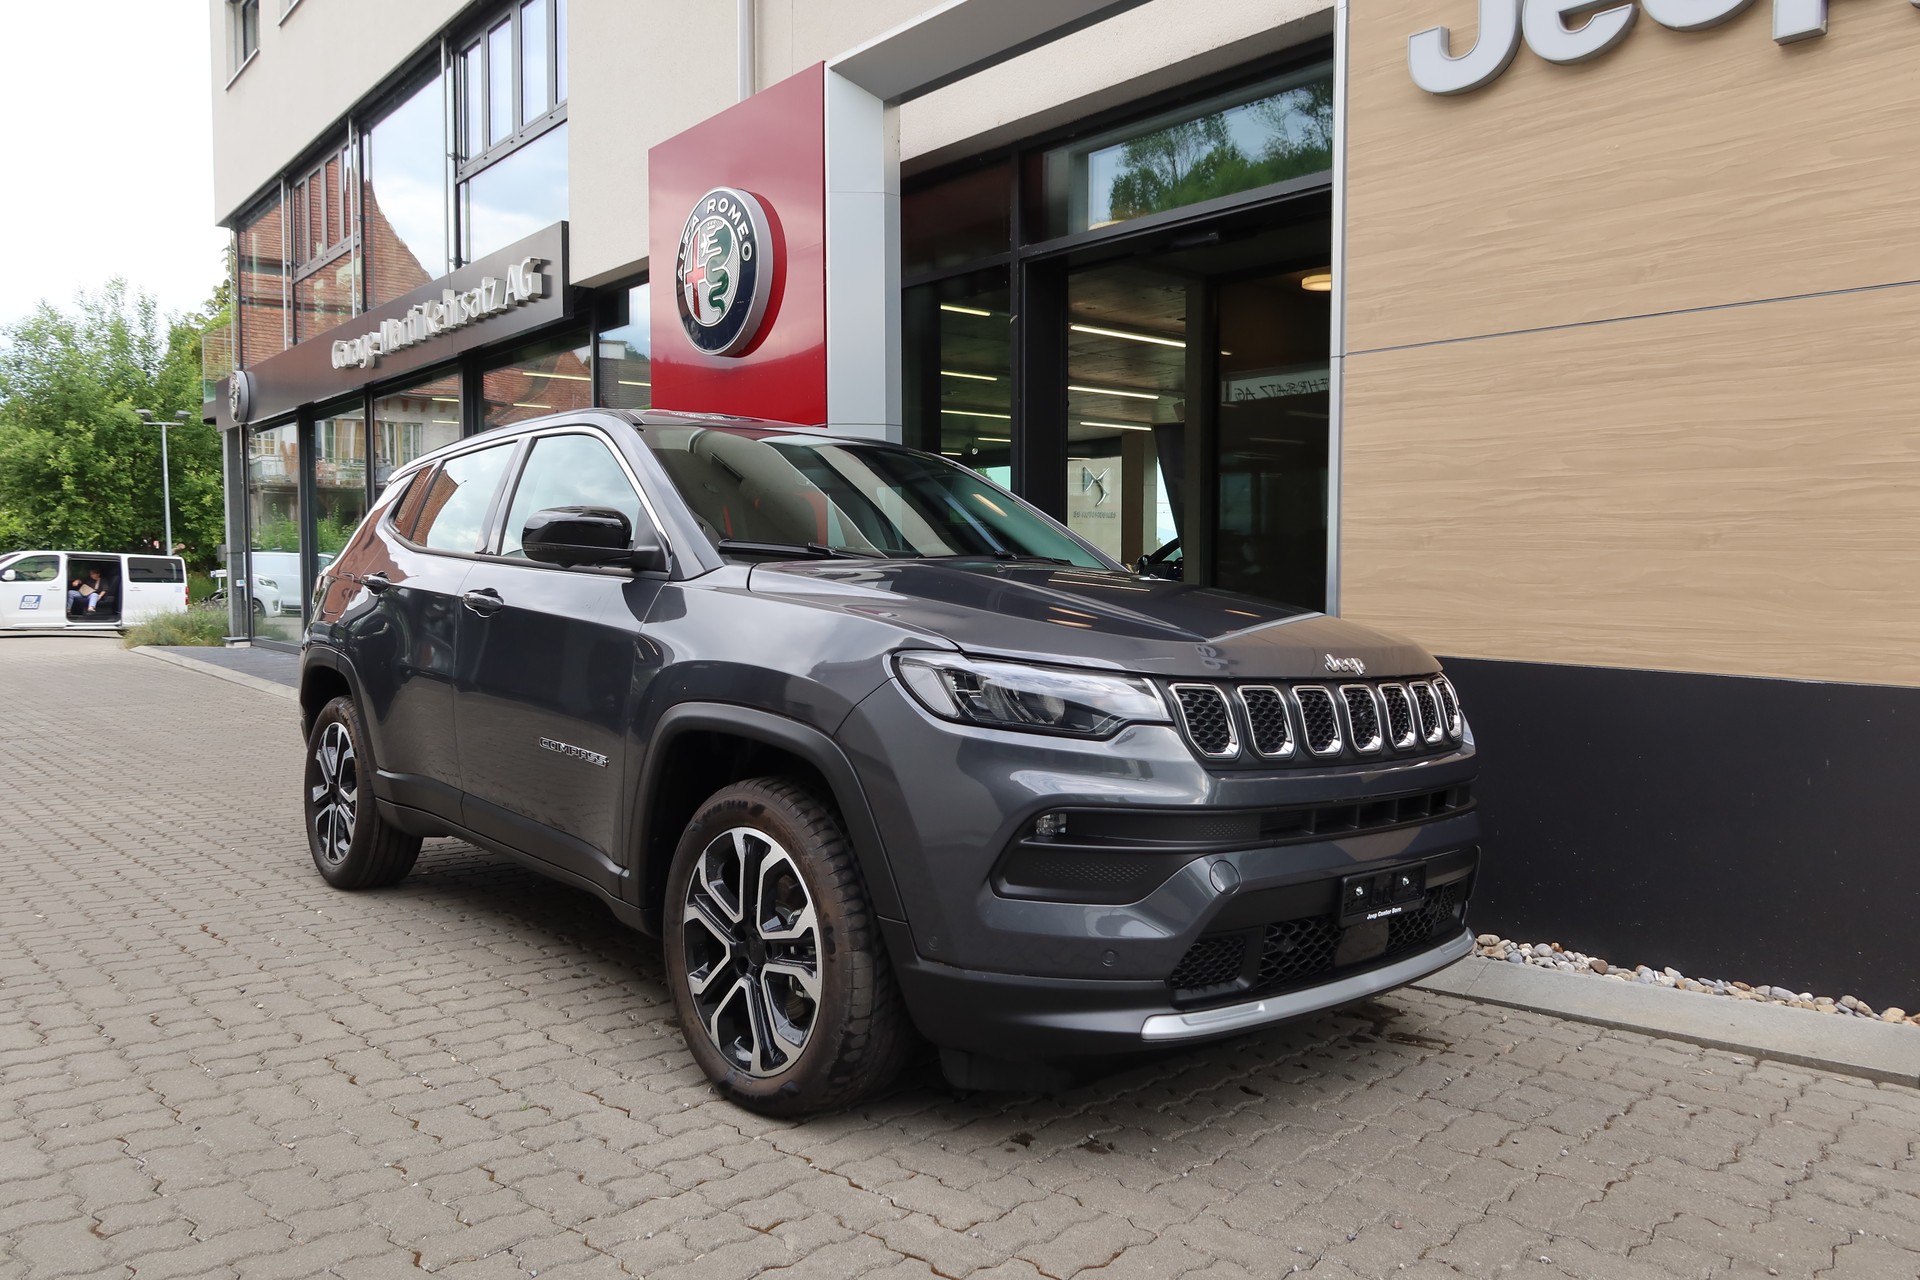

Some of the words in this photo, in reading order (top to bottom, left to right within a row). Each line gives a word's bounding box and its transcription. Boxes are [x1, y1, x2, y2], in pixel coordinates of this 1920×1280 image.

[677, 215, 700, 281] ALFA
[706, 197, 752, 261] ROMEO
[504, 256, 542, 306] AG
[1325, 653, 1366, 676] Jeep
[539, 736, 609, 768] COMPASS
